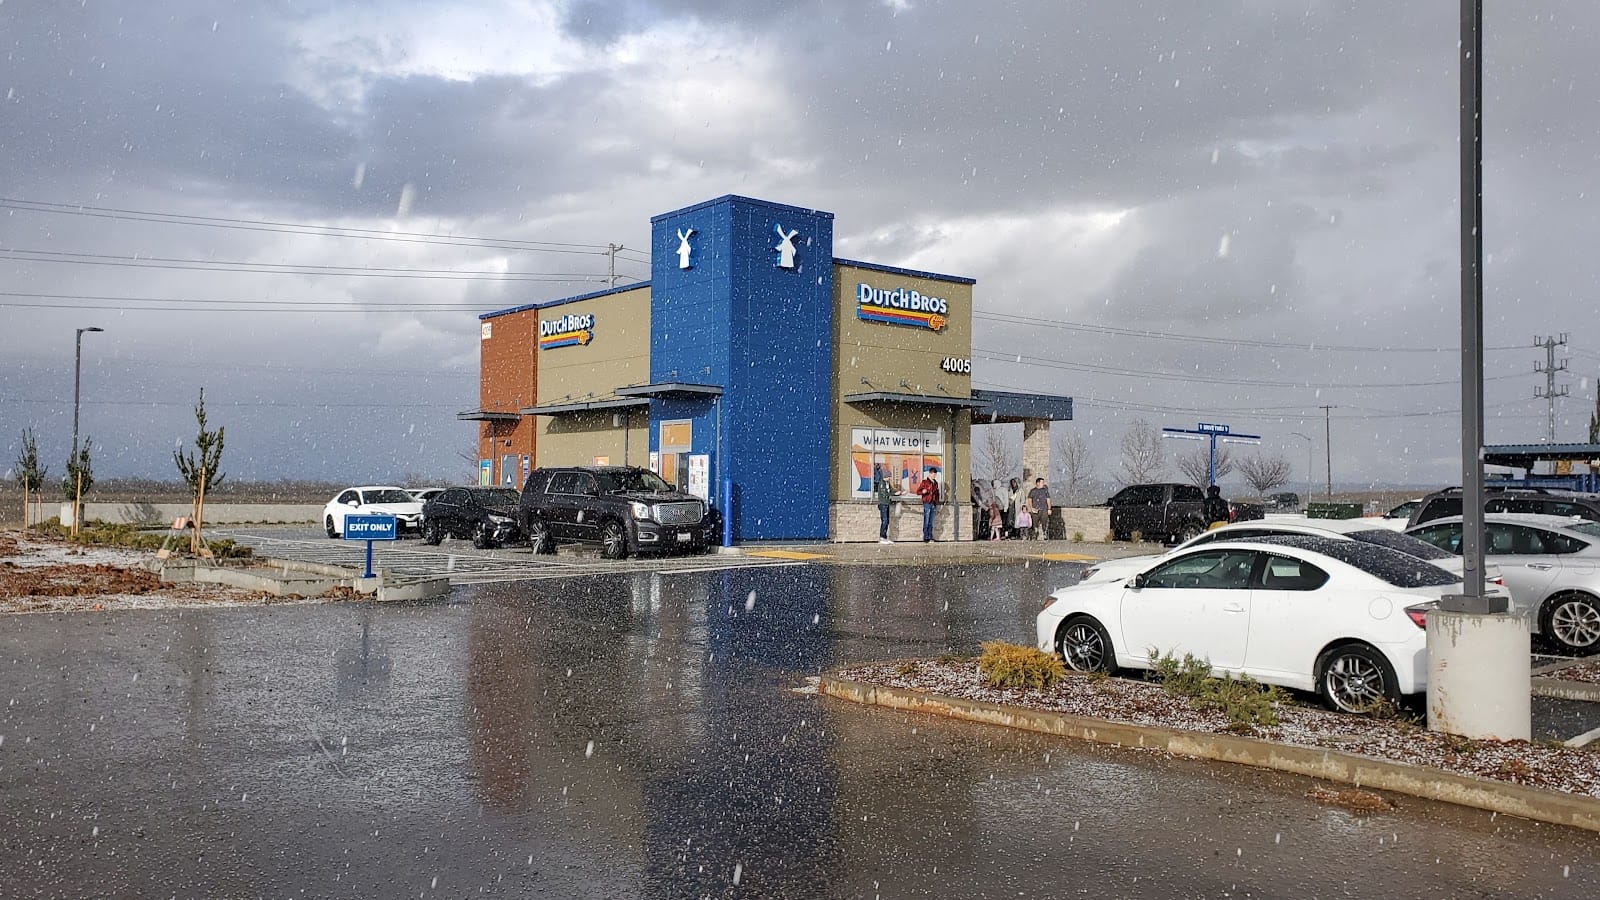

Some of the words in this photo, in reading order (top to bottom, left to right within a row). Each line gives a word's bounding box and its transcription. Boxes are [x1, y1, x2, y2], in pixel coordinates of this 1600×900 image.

[860, 283, 909, 310] DUTCH
[911, 290, 947, 314] BROS
[540, 316, 567, 336] DUTCH
[568, 314, 592, 332] BROS
[942, 358, 971, 373] 4005
[863, 435, 890, 446] WHAT
[892, 436, 906, 447] WE
[349, 523, 370, 532] EXIT
[370, 523, 393, 532] ONLY
